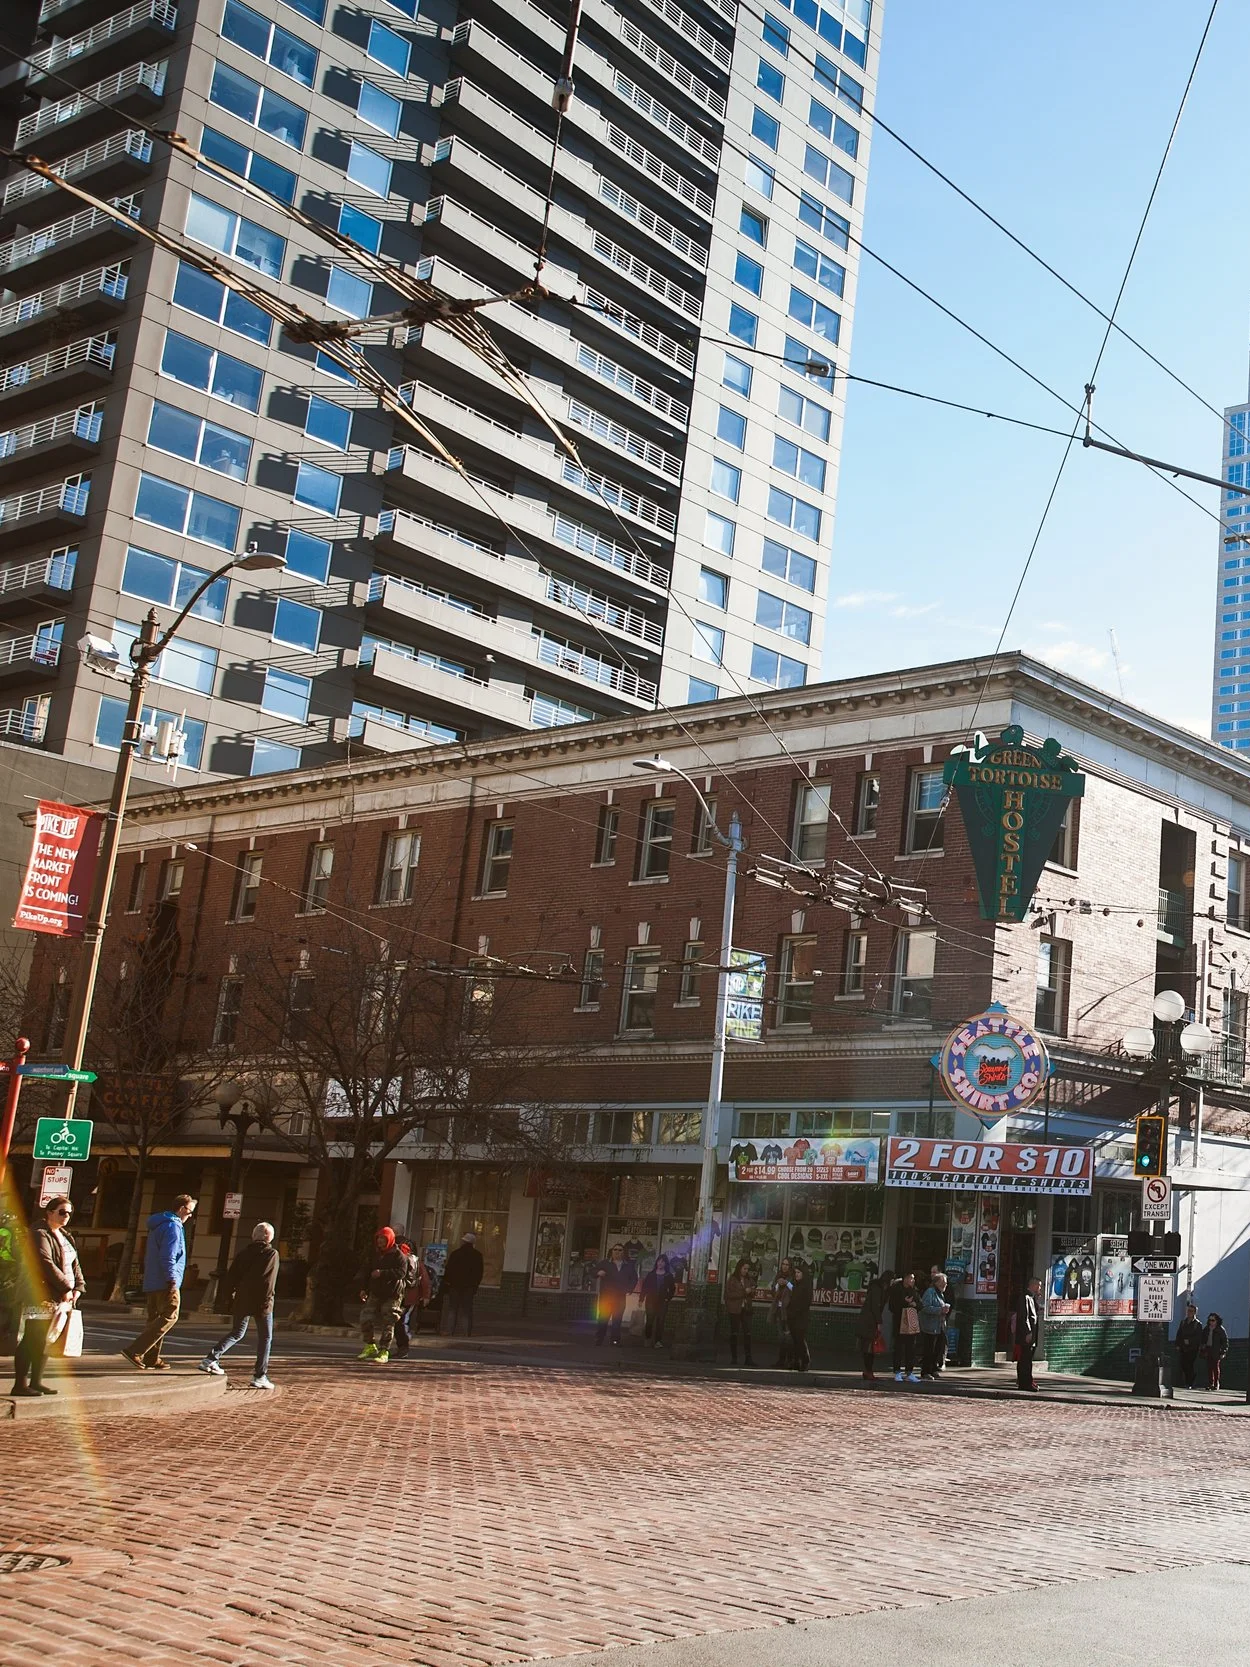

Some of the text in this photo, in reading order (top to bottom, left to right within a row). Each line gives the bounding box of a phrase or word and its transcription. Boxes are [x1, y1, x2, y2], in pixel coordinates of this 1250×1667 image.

[990, 750, 1042, 769] GREEN
[968, 766, 1063, 791] TORTOISE
[40, 814, 79, 837] PIKE UP!
[35, 842, 78, 861] THE NEW
[997, 790, 1025, 917] HOSTEL
[32, 858, 72, 875] MARKET
[28, 870, 63, 888] FRONT
[24, 886, 79, 906] IS COMING!
[19, 911, 63, 928] PikeUp.org
[951, 1018, 1040, 1060] SEATTLE
[949, 1069, 1010, 1111] SHIRT
[893, 1140, 1085, 1177] 2 FOR $10
[754, 1166, 776, 1175] $14.99
[891, 1171, 1086, 1189] 100% COTTON T-SHIRTS
[890, 1179, 966, 1189] PRE-PRINTED
[974, 1183, 1006, 1191] WHITE
[1144, 1261, 1172, 1269] ONE WAY
[832, 1291, 855, 1304] GEAR
